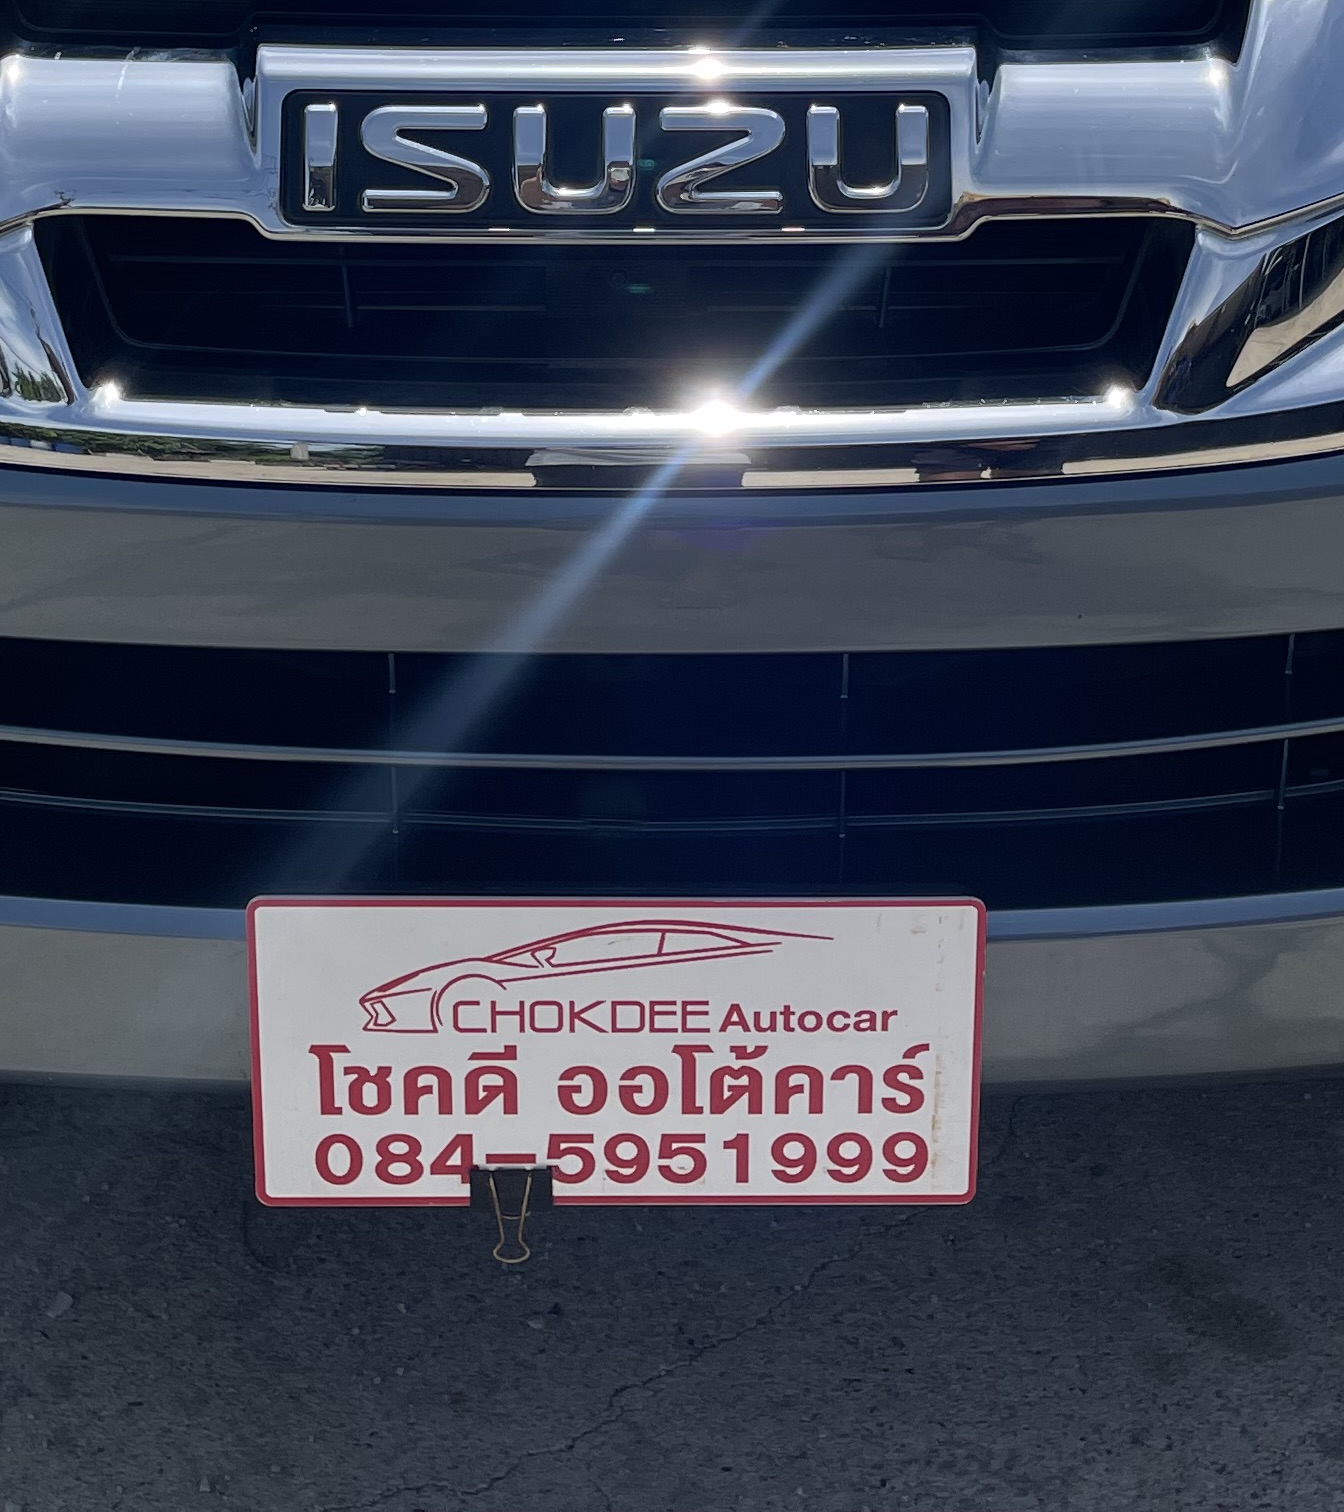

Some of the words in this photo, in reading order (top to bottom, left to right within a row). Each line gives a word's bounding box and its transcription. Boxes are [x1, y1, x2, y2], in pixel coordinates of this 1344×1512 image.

[303, 102, 930, 214] ISUZU
[452, 999, 710, 1034] CHOKDEE
[719, 1002, 898, 1034] Autocar
[308, 1044, 519, 1116] โชคดี
[556, 1043, 930, 1116] ออโต้คาร์
[314, 1131, 930, 1186] 084-5951999
